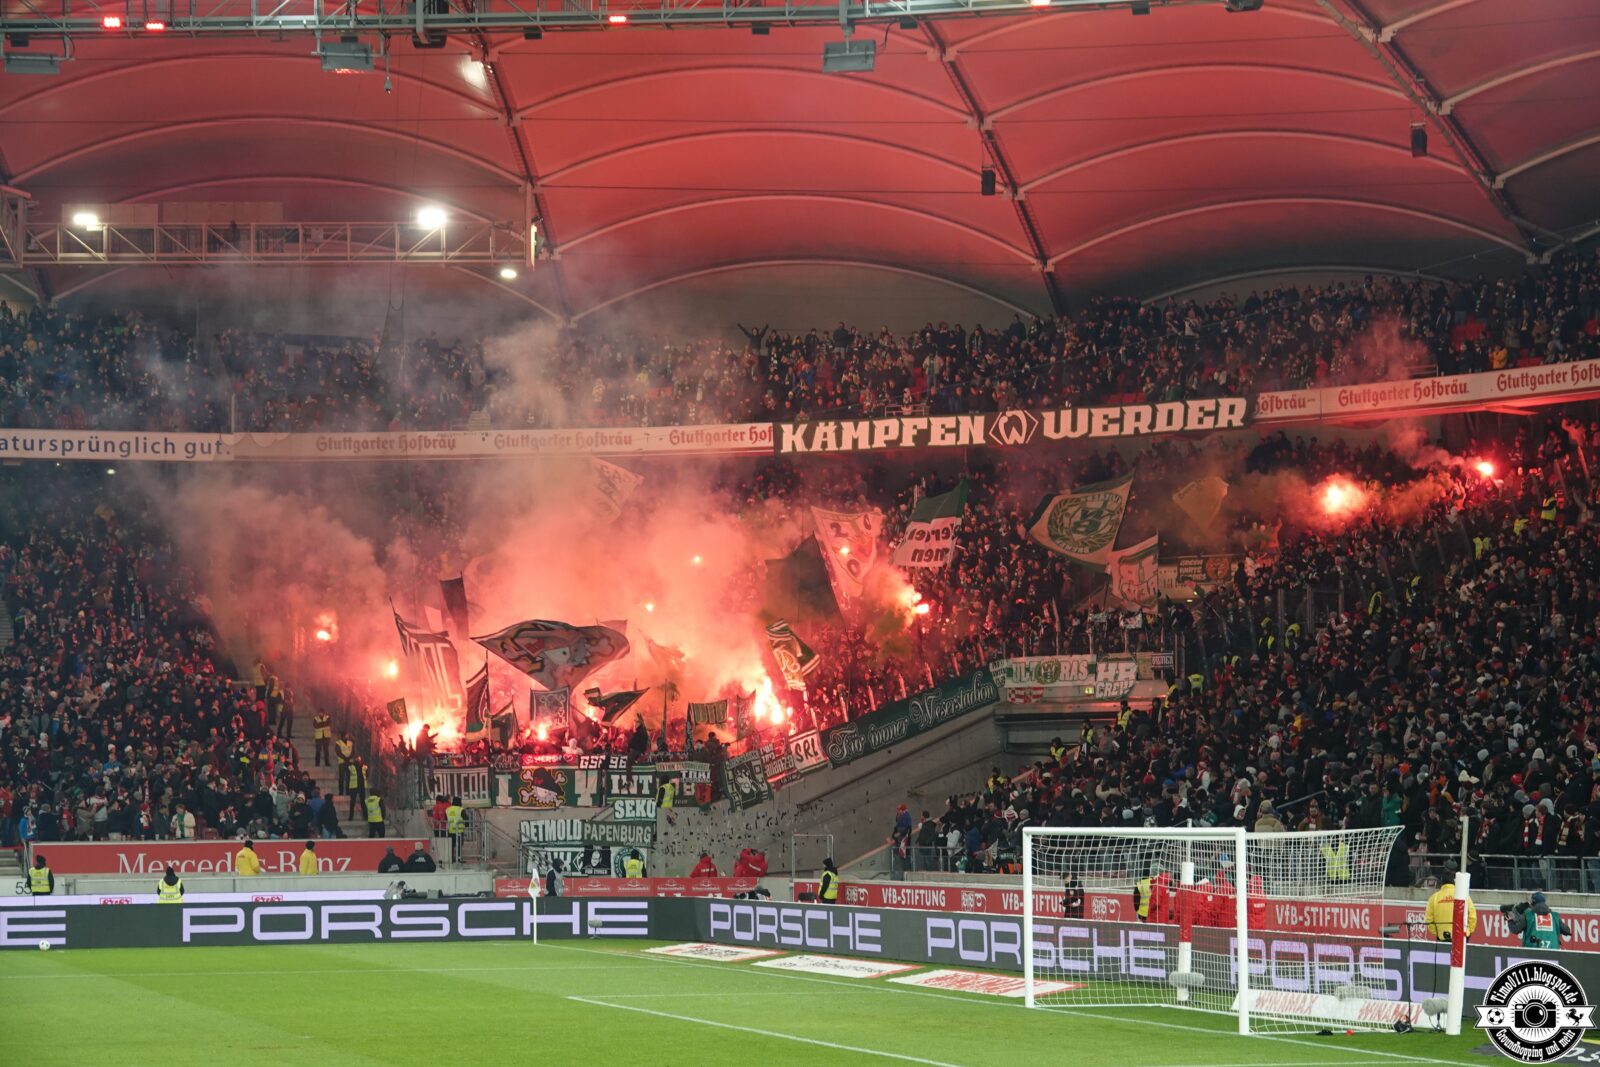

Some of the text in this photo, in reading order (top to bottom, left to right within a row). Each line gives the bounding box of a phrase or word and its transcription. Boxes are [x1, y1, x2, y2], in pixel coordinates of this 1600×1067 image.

[1497, 369, 1568, 392] Stuttgarter
[1338, 381, 1468, 408] Stuttgarter Hofbräu
[780, 414, 985, 453] KÄMPFEN
[1042, 397, 1247, 440] WERDER
[184, 439, 231, 460] gut.
[316, 434, 456, 452] Stuttgarter Hofbräu
[494, 431, 633, 450] Stuttgarter Hofbräu
[669, 427, 746, 449] Stuttgarter
[868, 719, 909, 749] immer
[910, 671, 994, 729] Weserstadion
[520, 819, 652, 843] DETMOLD PAPENBURG
[881, 887, 946, 908] VfB-STIFTUNG
[182, 901, 649, 944] PORSCHE
[710, 903, 882, 953] PORSCHE
[1275, 904, 1370, 930] VfB-STIFTUNG
[926, 916, 1167, 978] PORSCHE
